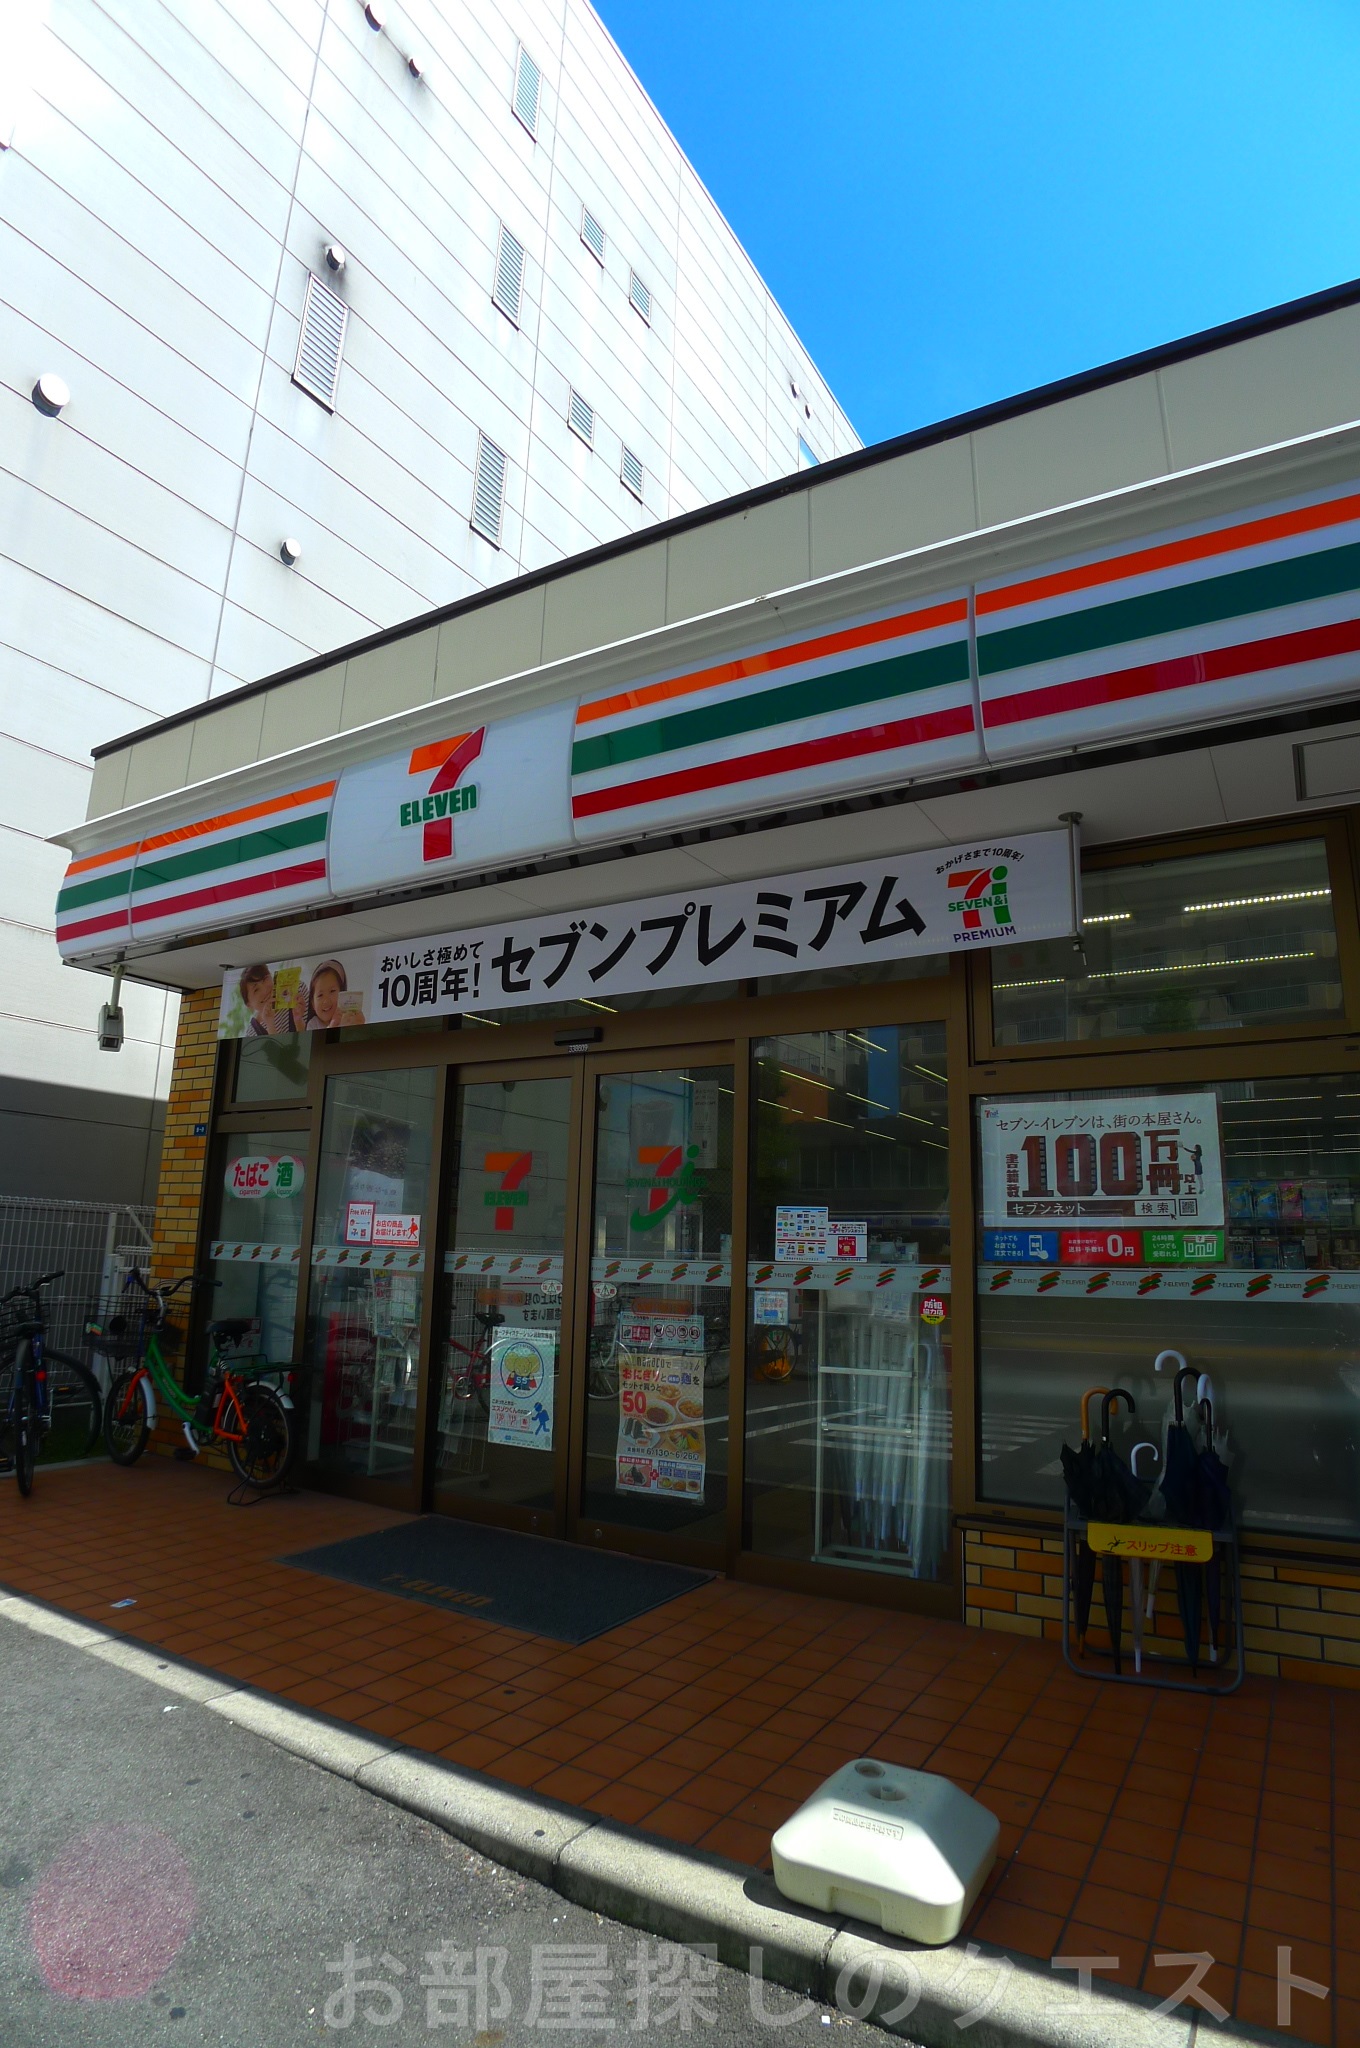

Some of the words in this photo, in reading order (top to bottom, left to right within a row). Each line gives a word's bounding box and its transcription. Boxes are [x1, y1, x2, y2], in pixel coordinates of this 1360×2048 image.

[935, 847, 1025, 875] おかげさまで10周年!
[492, 876, 927, 993] セブンプレミアム
[953, 925, 1017, 943] PREMIUM
[380, 940, 485, 973] おいしさ極めて
[378, 963, 482, 1008] 10周年!
[996, 1111, 1202, 1132] セブン-イレブンは、街の本屋さん。
[233, 1162, 269, 1187] たばこ
[276, 1162, 293, 1187] 酒
[1020, 1132, 1143, 1198] 100
[1183, 1174, 1197, 1195] 以上
[350, 1208, 360, 1216] Free
[360, 1208, 371, 1216] Wi-Fi
[1012, 1202, 1086, 1216] セブンネット
[622, 1390, 647, 1414] 50
[1126, 1540, 1198, 1557] スリップ注意
